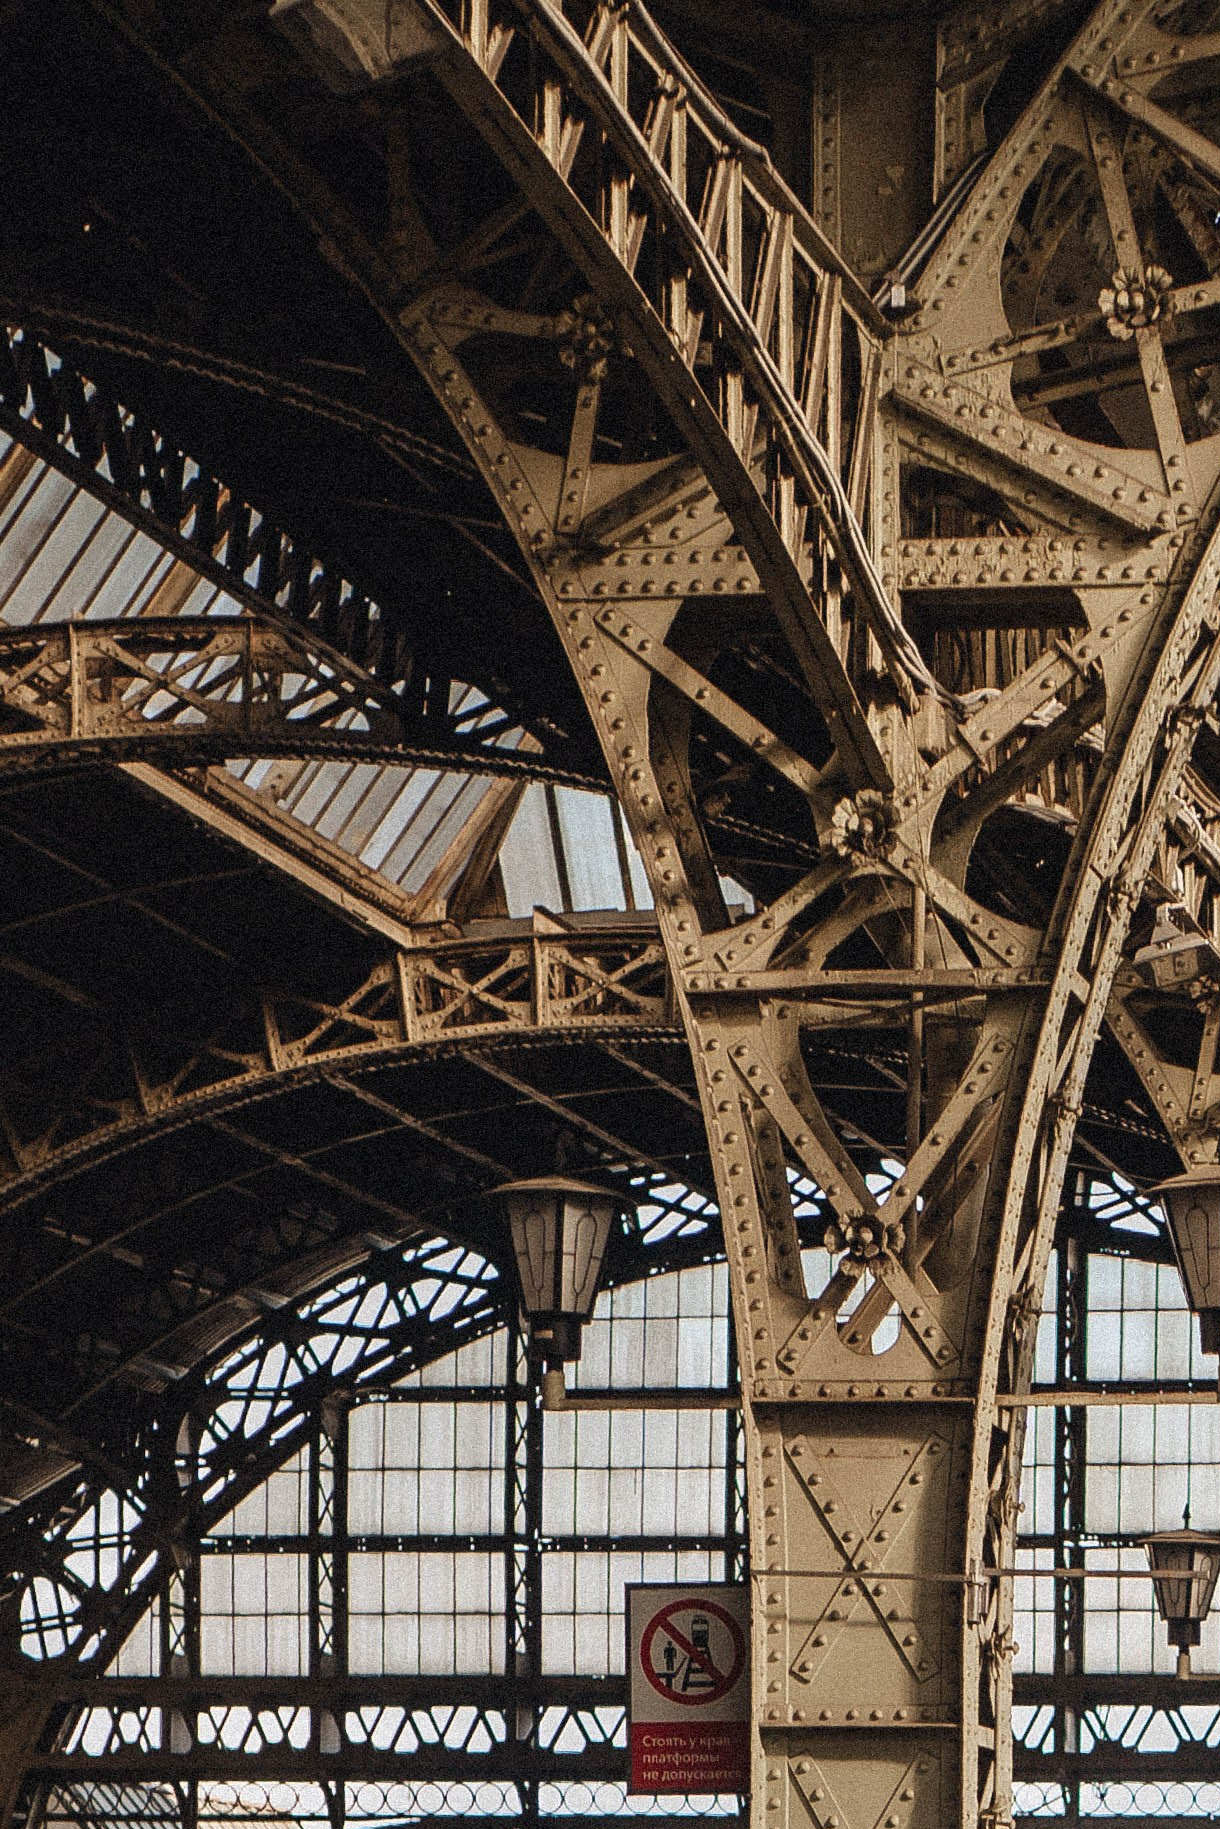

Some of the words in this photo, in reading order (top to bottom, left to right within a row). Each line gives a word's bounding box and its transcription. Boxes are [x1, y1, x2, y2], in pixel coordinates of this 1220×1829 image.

[642, 1735, 687, 1747] Стоять
[689, 1737, 697, 1749] у
[700, 1737, 731, 1749] края
[642, 1752, 720, 1766] платформы
[643, 1770, 659, 1780] не
